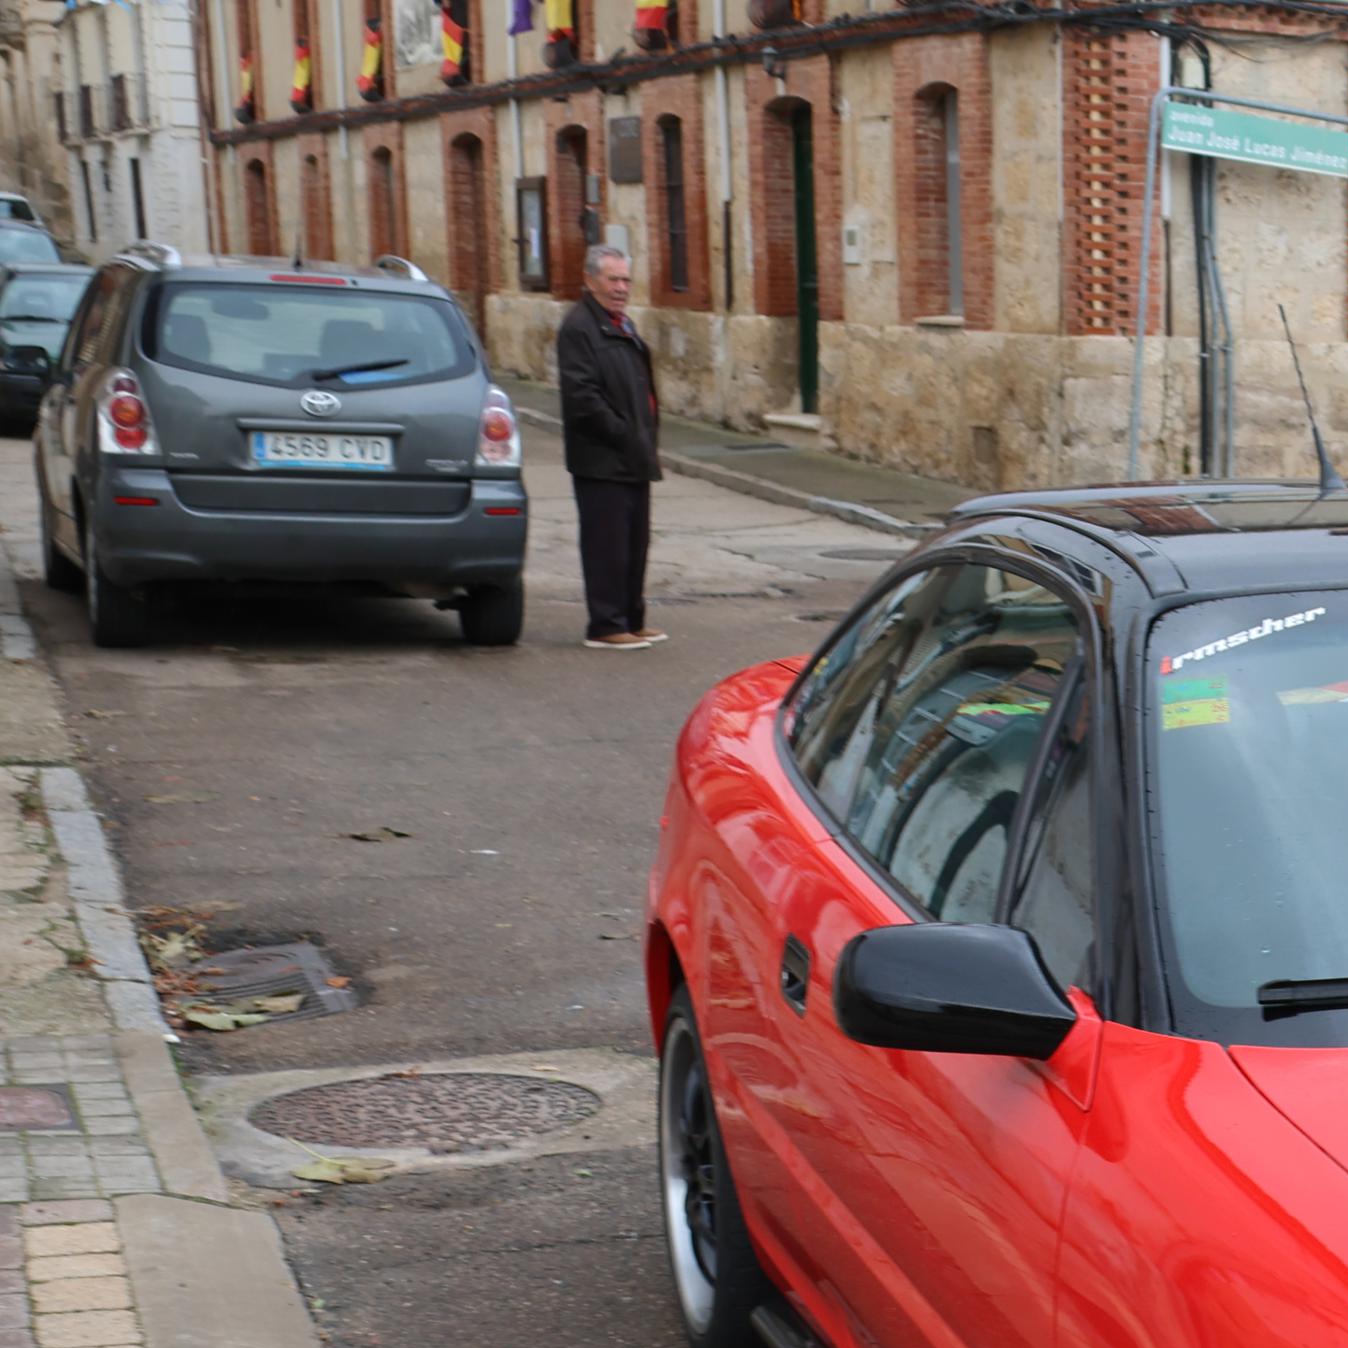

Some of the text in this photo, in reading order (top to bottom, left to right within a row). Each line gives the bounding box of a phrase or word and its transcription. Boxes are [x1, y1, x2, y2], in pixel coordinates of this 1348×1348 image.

[1168, 126, 1348, 168] Juan José Lucas Jiménez
[270, 435, 328, 458] 4569
[1160, 607, 1326, 676] irmscher
